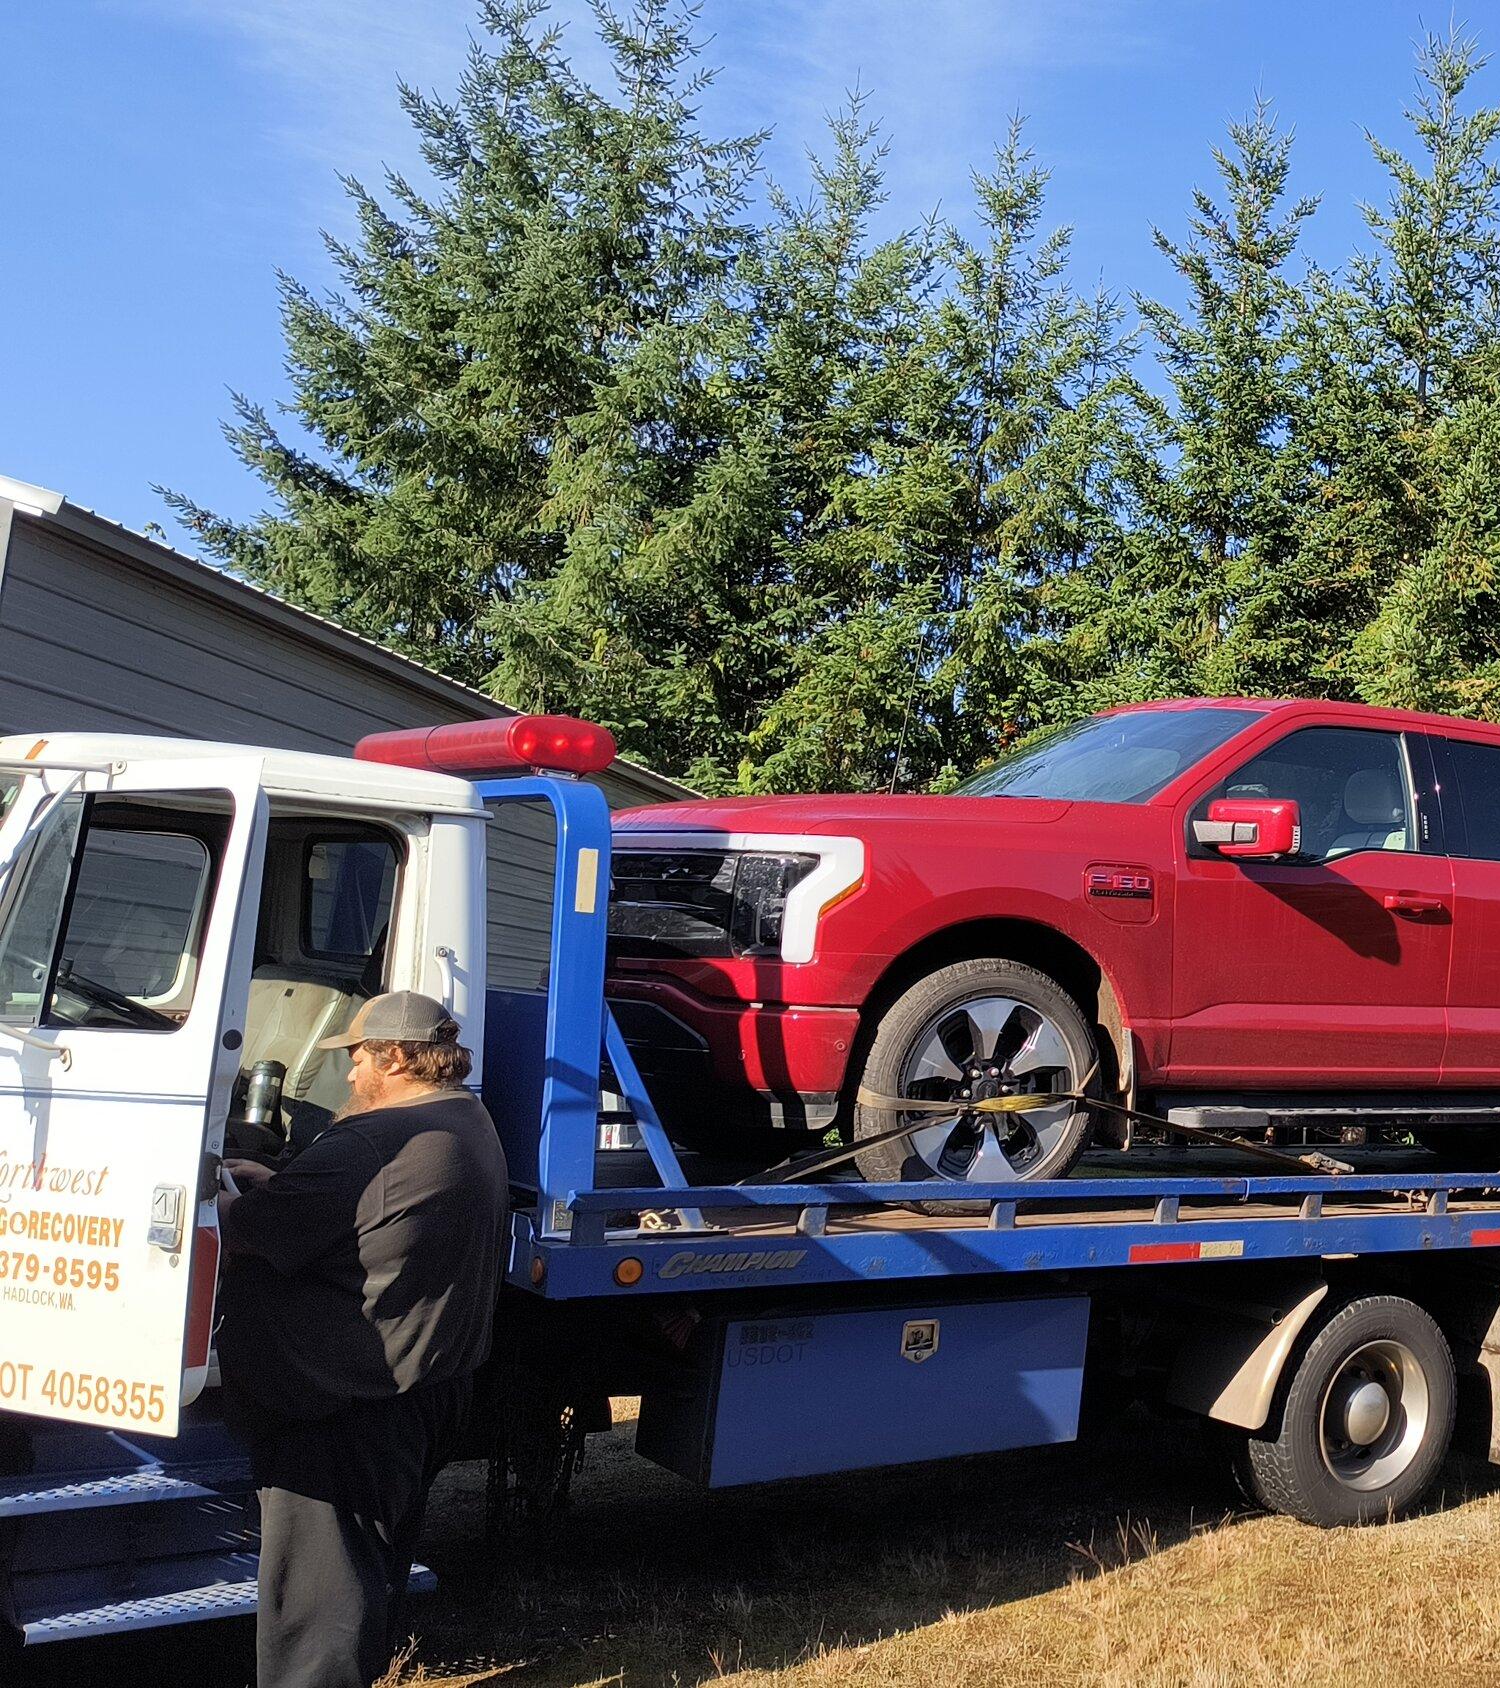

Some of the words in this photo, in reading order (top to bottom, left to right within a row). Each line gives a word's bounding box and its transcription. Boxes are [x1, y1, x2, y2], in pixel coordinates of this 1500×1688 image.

[1088, 874, 1149, 889] F-150
[0, 1150, 109, 1198] orthwest
[28, 1210, 124, 1247] RECOVERY
[727, 1342, 807, 1368] USDOT
[0, 1361, 33, 1400] OT
[41, 1369, 164, 1422] 4058355
